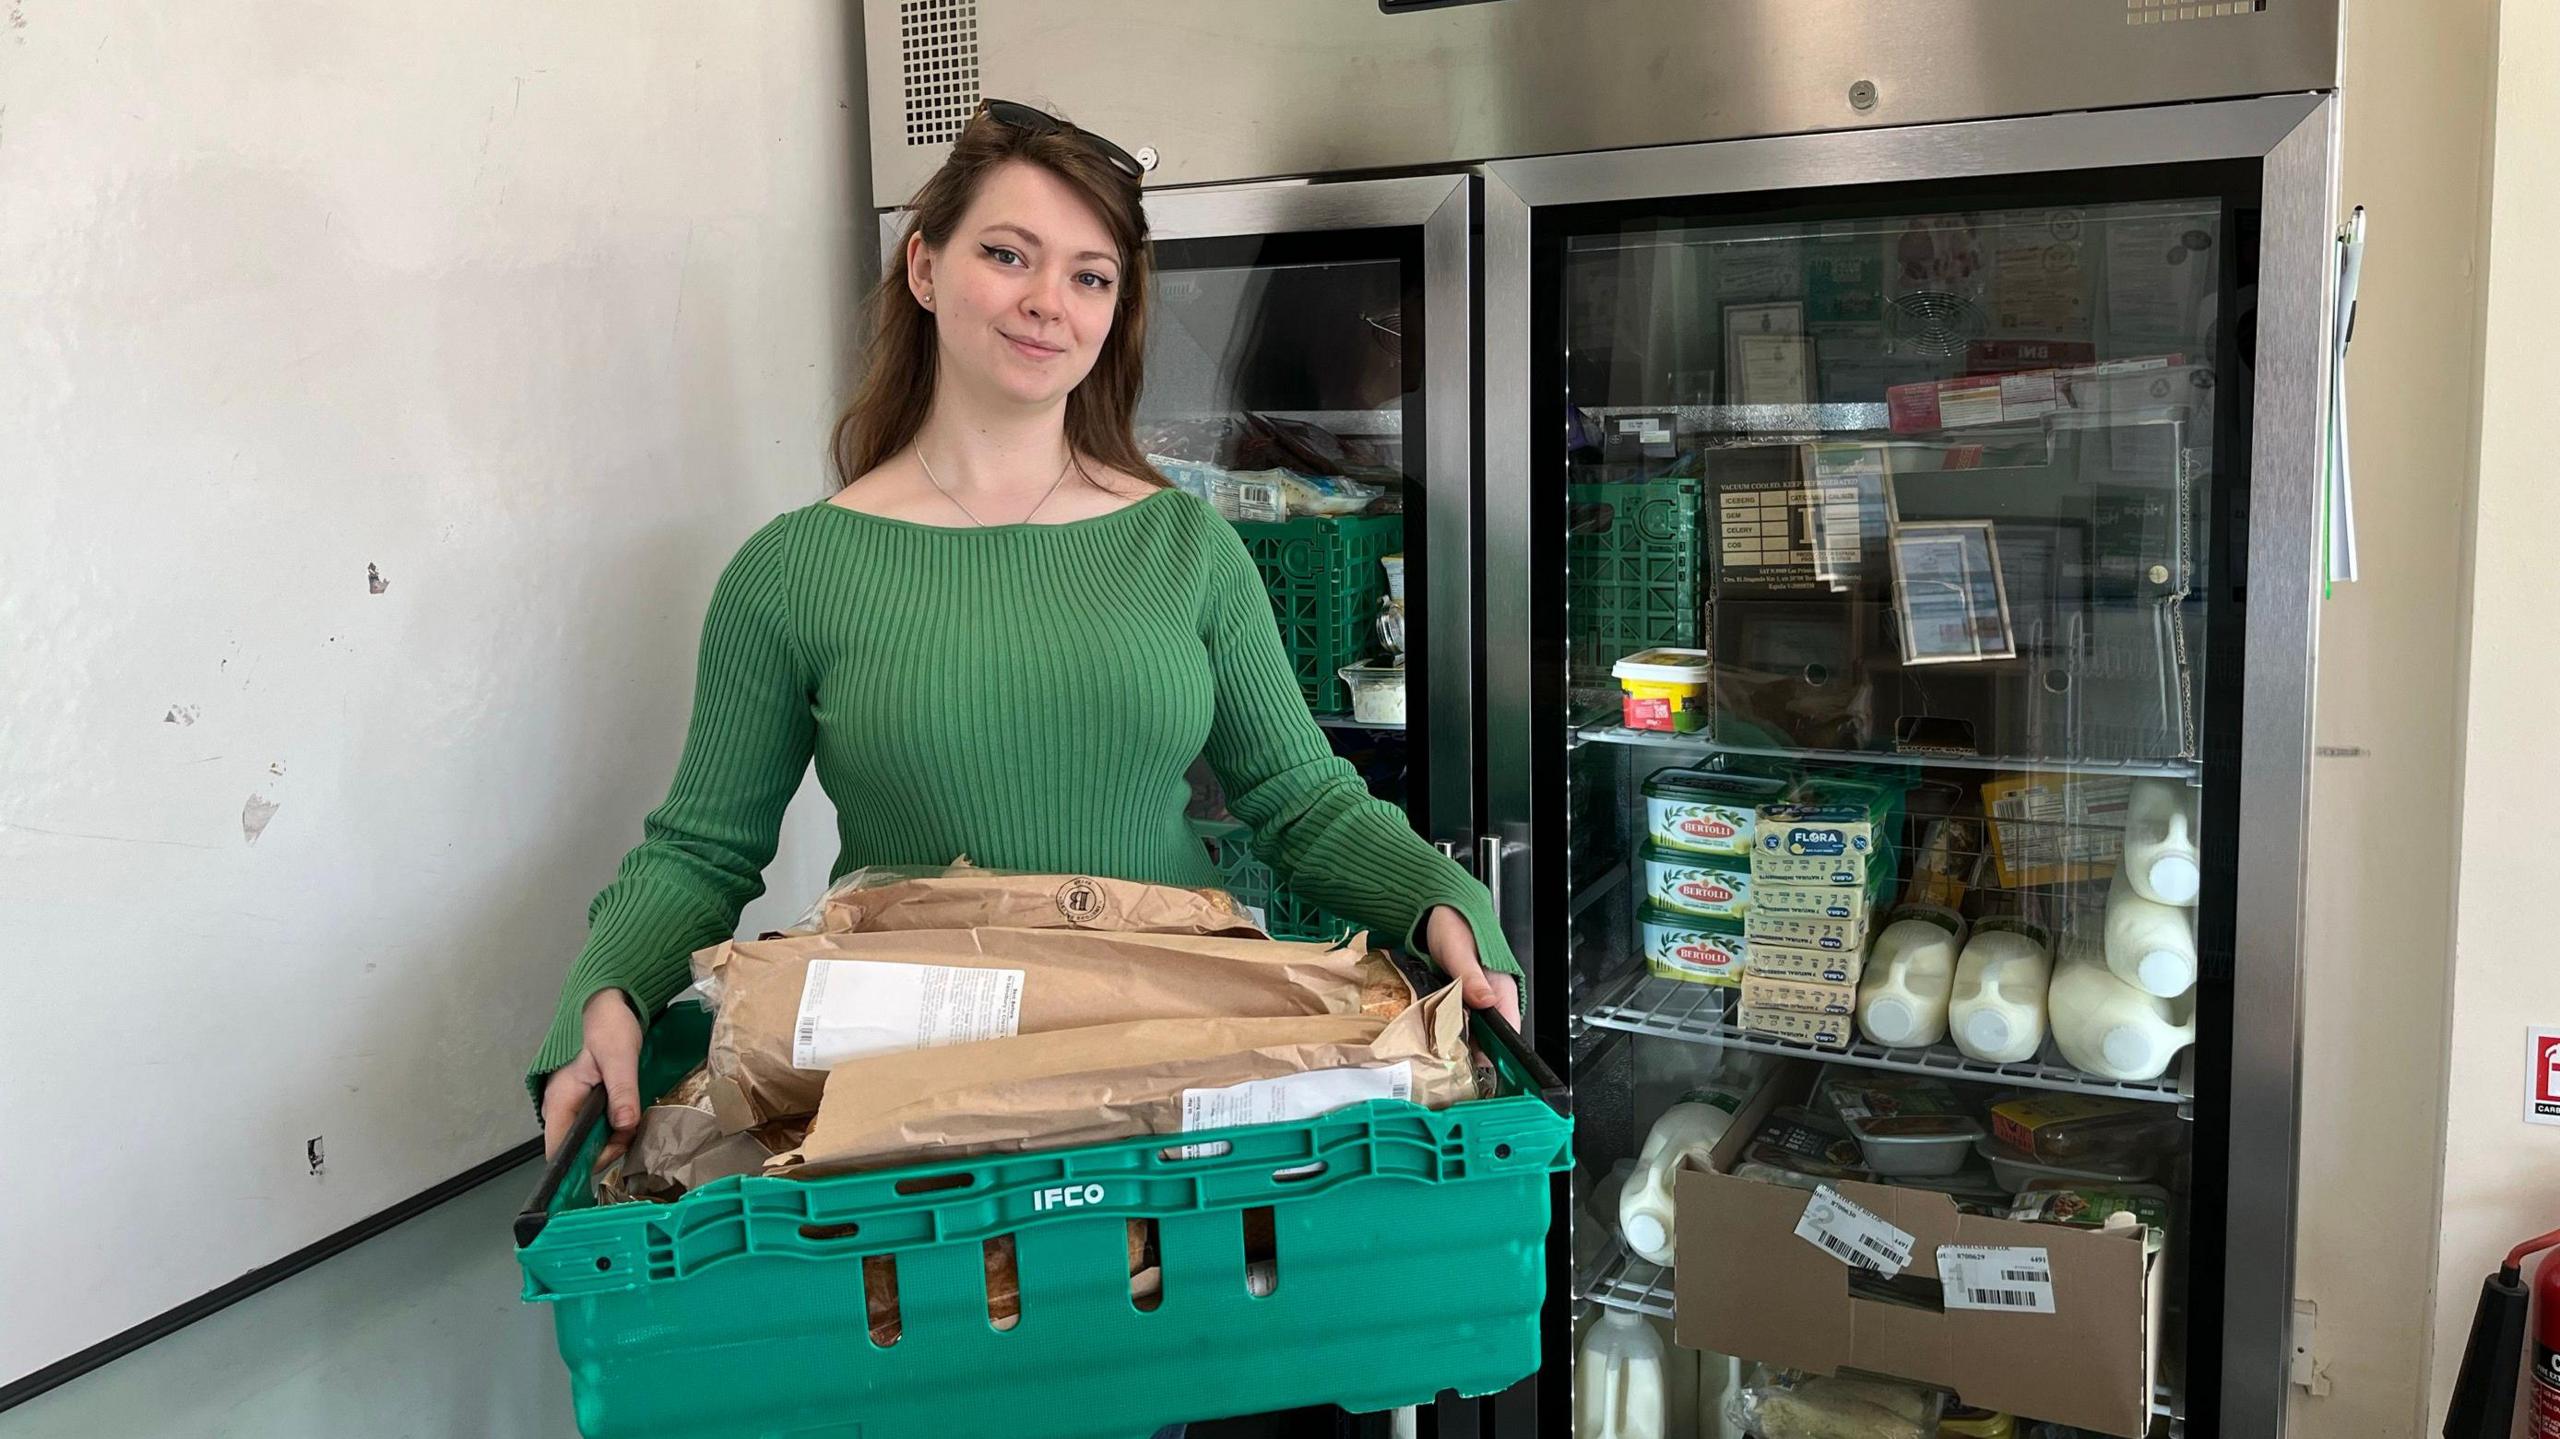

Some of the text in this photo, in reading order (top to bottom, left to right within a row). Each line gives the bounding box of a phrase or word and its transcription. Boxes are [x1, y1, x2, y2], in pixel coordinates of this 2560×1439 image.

[1720, 483, 1750, 491] VACUUM
[1684, 822, 1731, 836] BERTOLLI
[1795, 832, 1838, 843] FLORA
[1683, 885, 1729, 900] BERTOLLI
[1680, 948, 1726, 963] BERTOLLI
[1034, 1184, 1105, 1211] IFCO
[1806, 1203, 1835, 1231] 2
